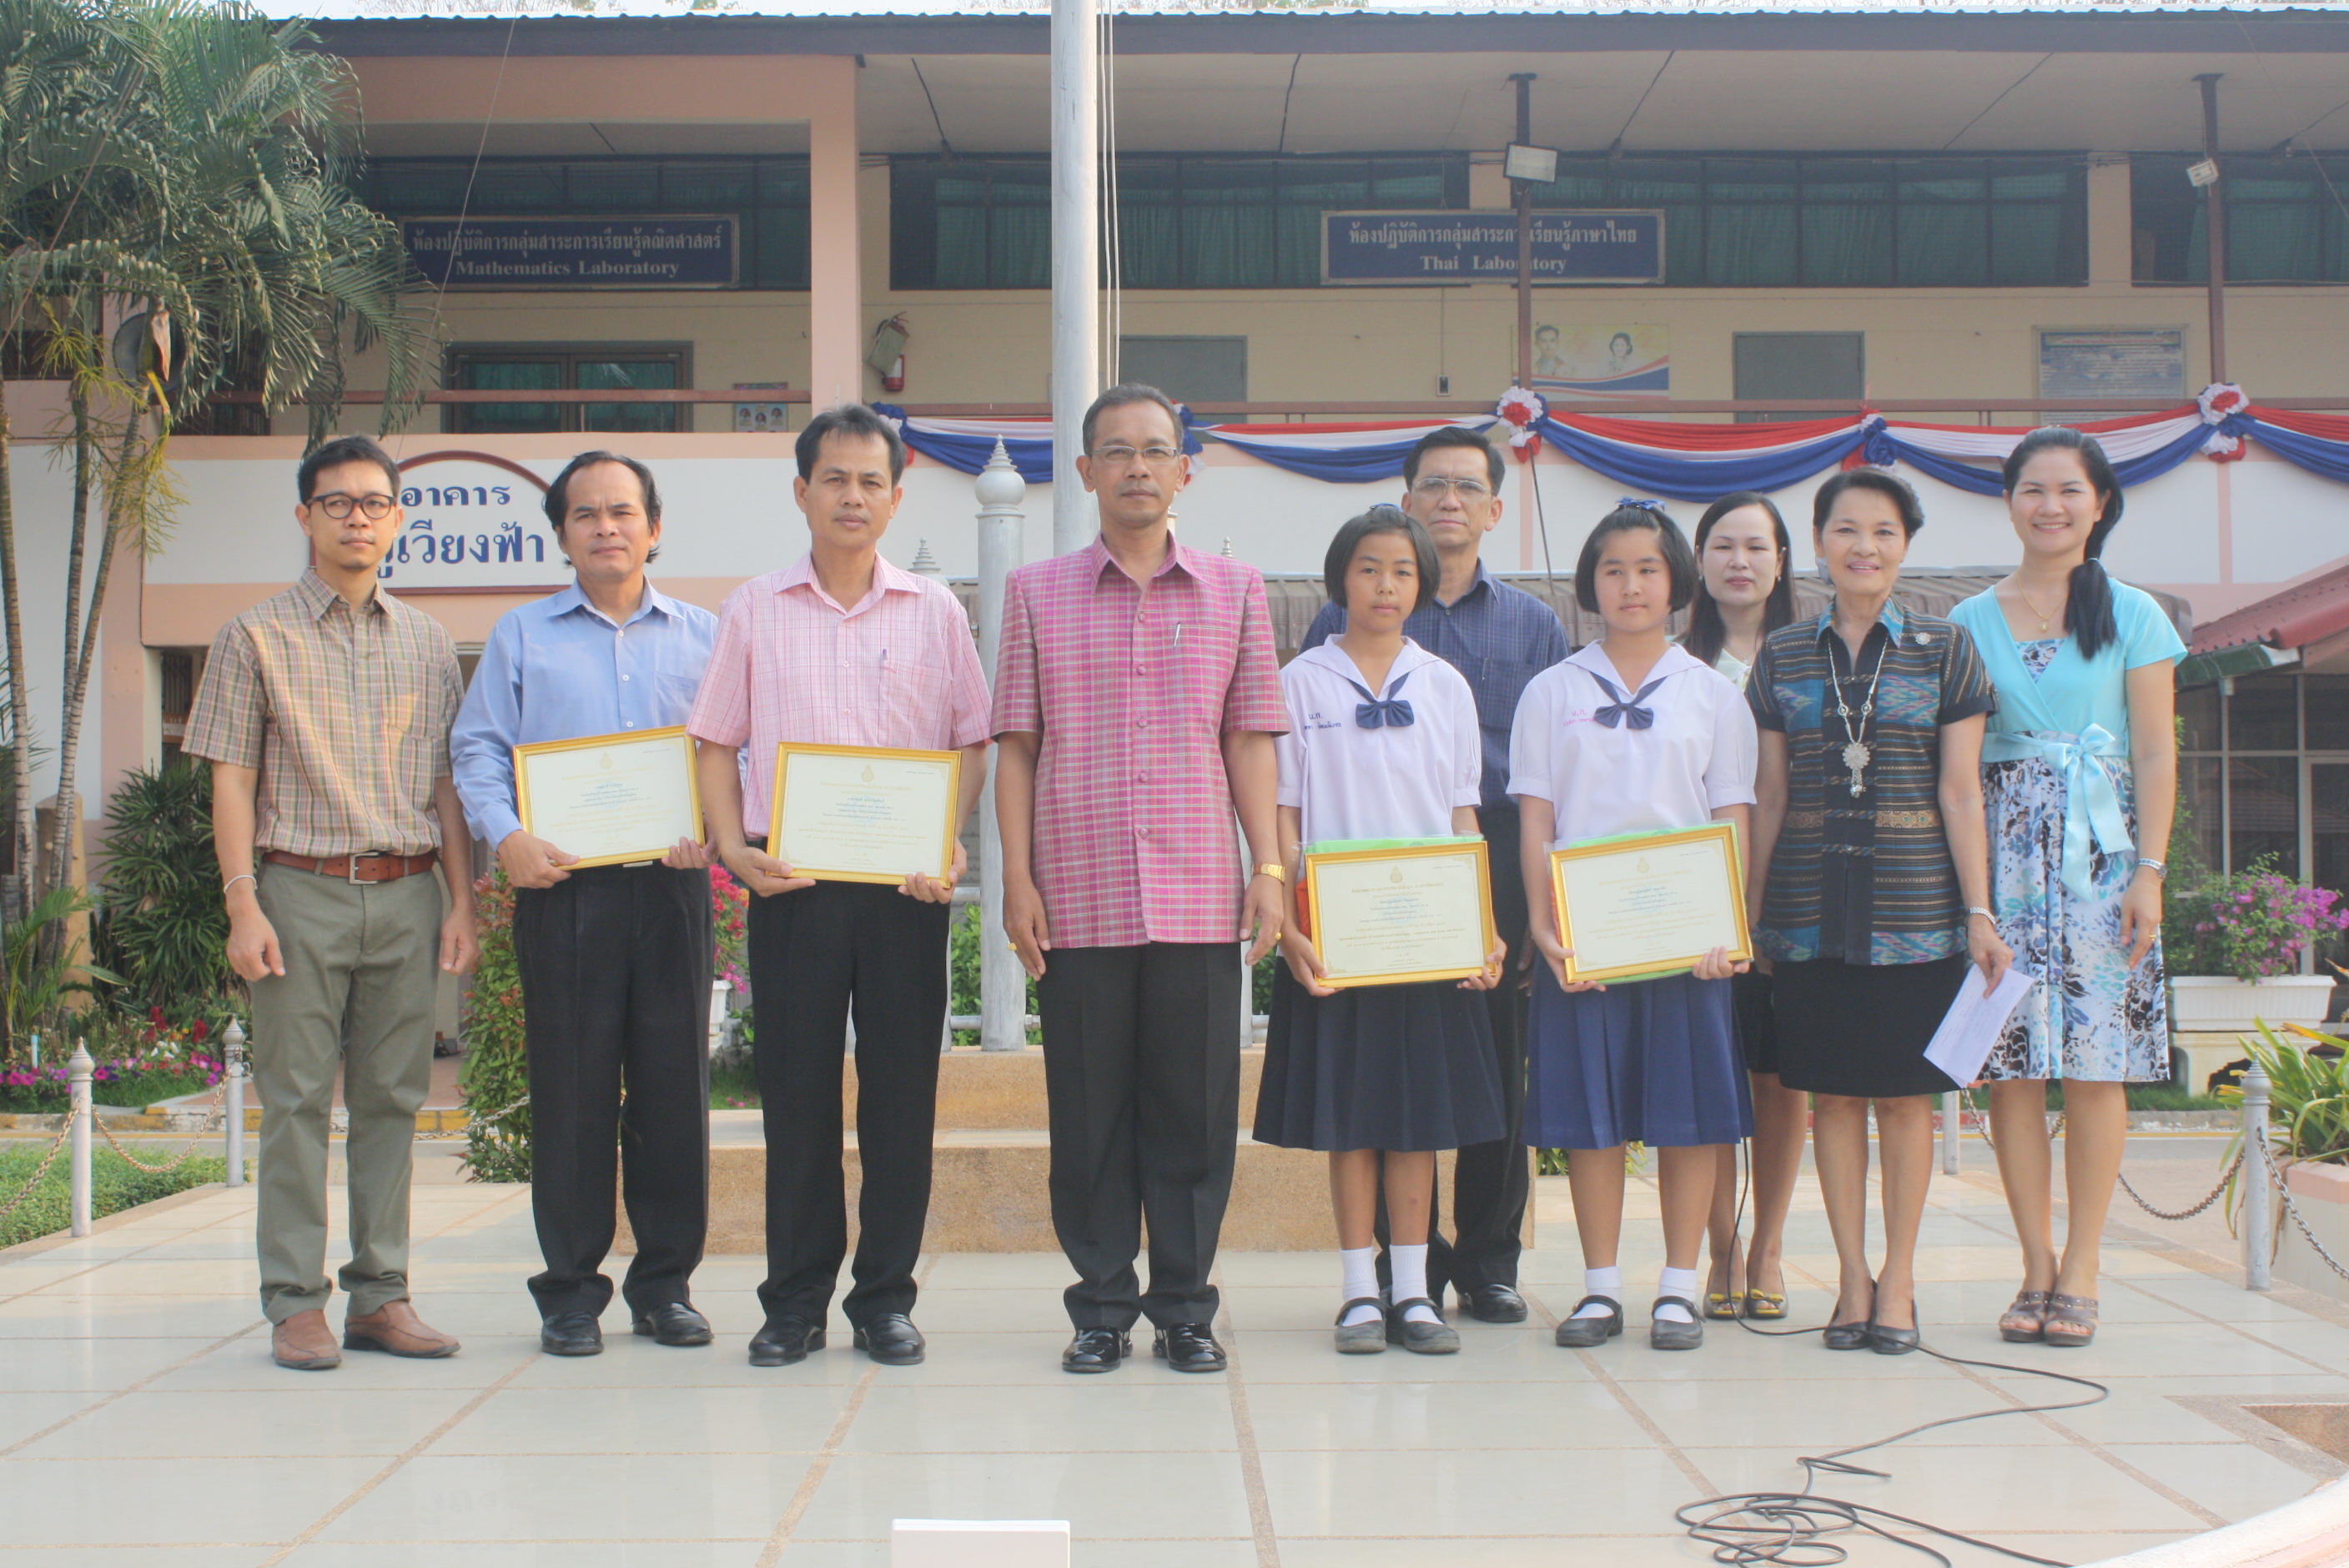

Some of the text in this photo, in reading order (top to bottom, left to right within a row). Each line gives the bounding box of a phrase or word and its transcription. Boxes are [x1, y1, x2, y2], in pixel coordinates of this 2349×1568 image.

[1349, 220, 1637, 250] ห้องปฏิบัติการกลุ่มสาระกเรียนรู้ภาษาไทย
[455, 261, 679, 278] Mathematics Laboratory
[1421, 255, 1567, 274] Thai Labotory
[400, 486, 511, 507] อาคาร
